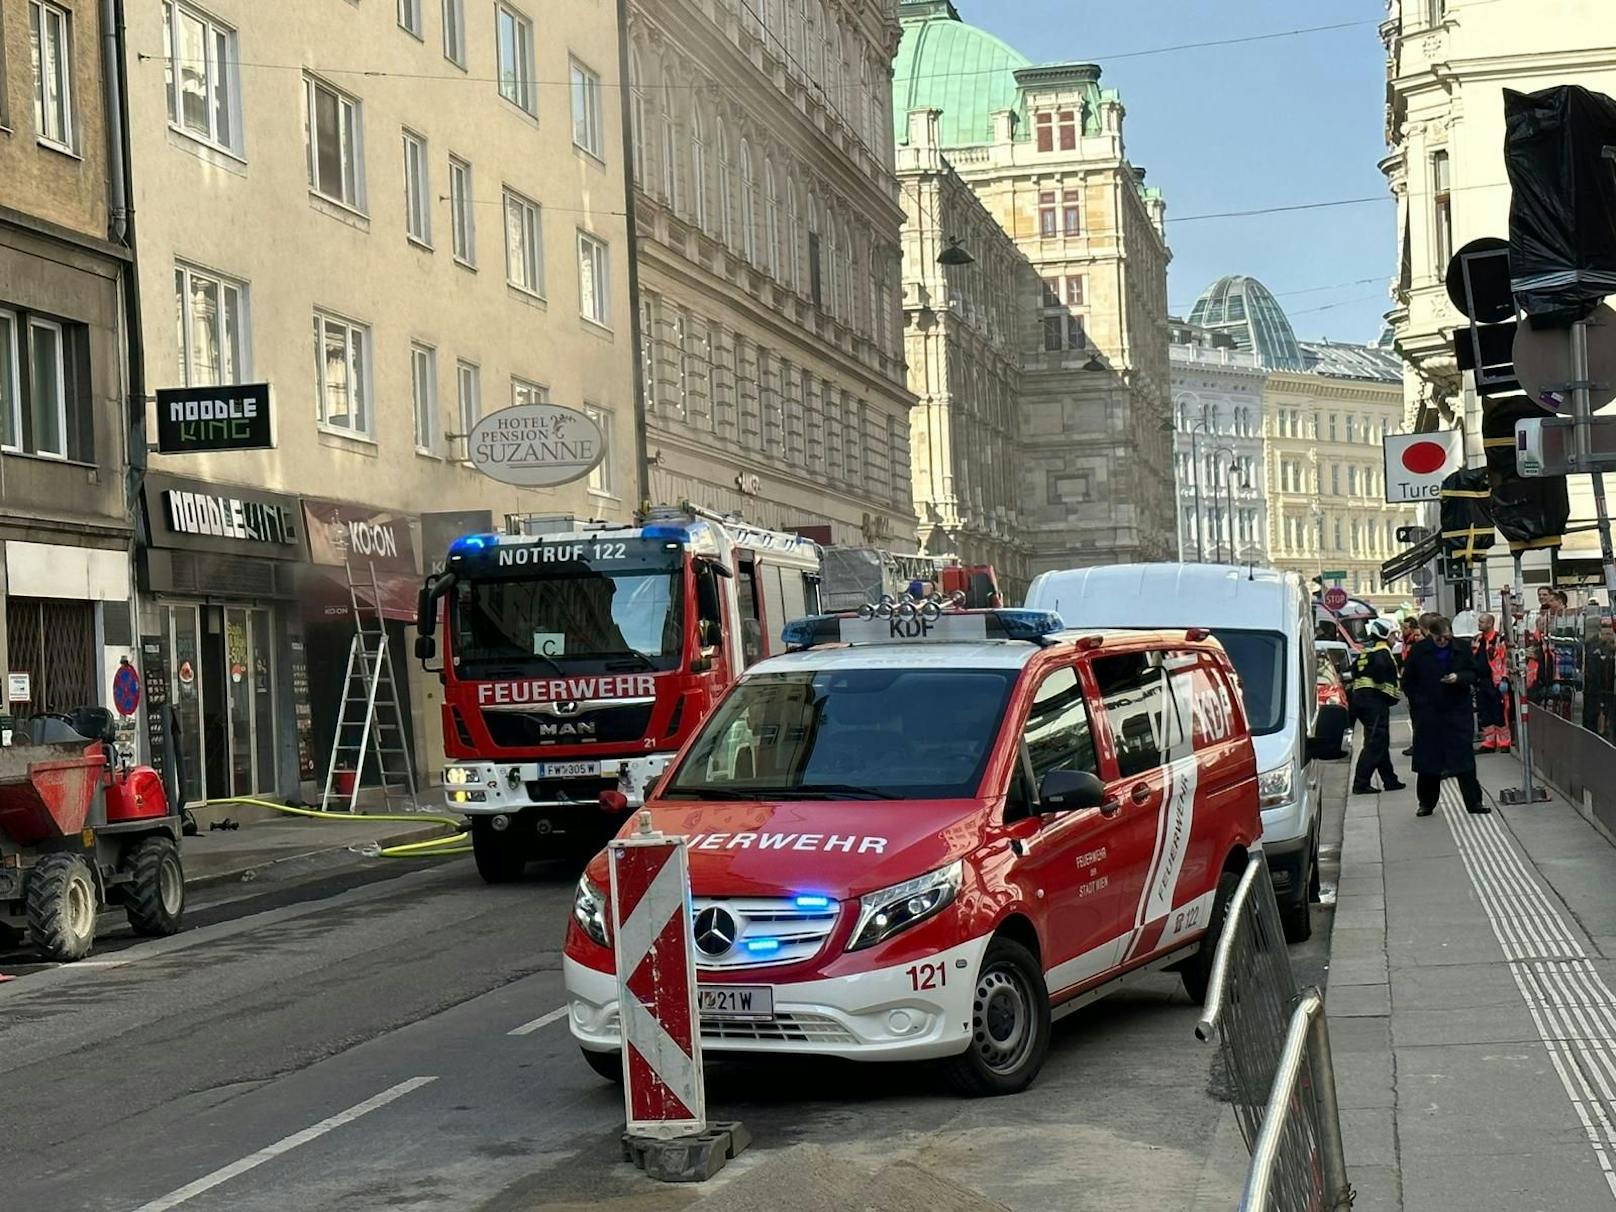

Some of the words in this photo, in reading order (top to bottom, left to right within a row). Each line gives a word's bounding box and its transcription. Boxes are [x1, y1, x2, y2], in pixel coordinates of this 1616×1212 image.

[170, 398, 257, 421] NOODLE
[181, 419, 250, 441] KING
[498, 416, 549, 430] HOTEL
[482, 429, 549, 443] PENSION
[476, 440, 593, 464] SUZANNE
[348, 520, 398, 557] KO:ON
[499, 544, 583, 566] NOTRUF
[593, 543, 626, 560] 122
[1326, 595, 1346, 604] STOP
[889, 617, 934, 638] KDF
[477, 676, 656, 704] FEUERWEHR
[539, 721, 596, 736] MAN
[644, 738, 656, 748] 21
[548, 765, 561, 775] FW
[569, 764, 586, 774] 305
[1158, 773, 1189, 903] FEUERWEHR
[1076, 846, 1107, 869] FEUERWEHR
[1184, 905, 1200, 929] 122
[906, 961, 946, 991] 121
[717, 991, 736, 1010] 21
[739, 991, 752, 1011] W
